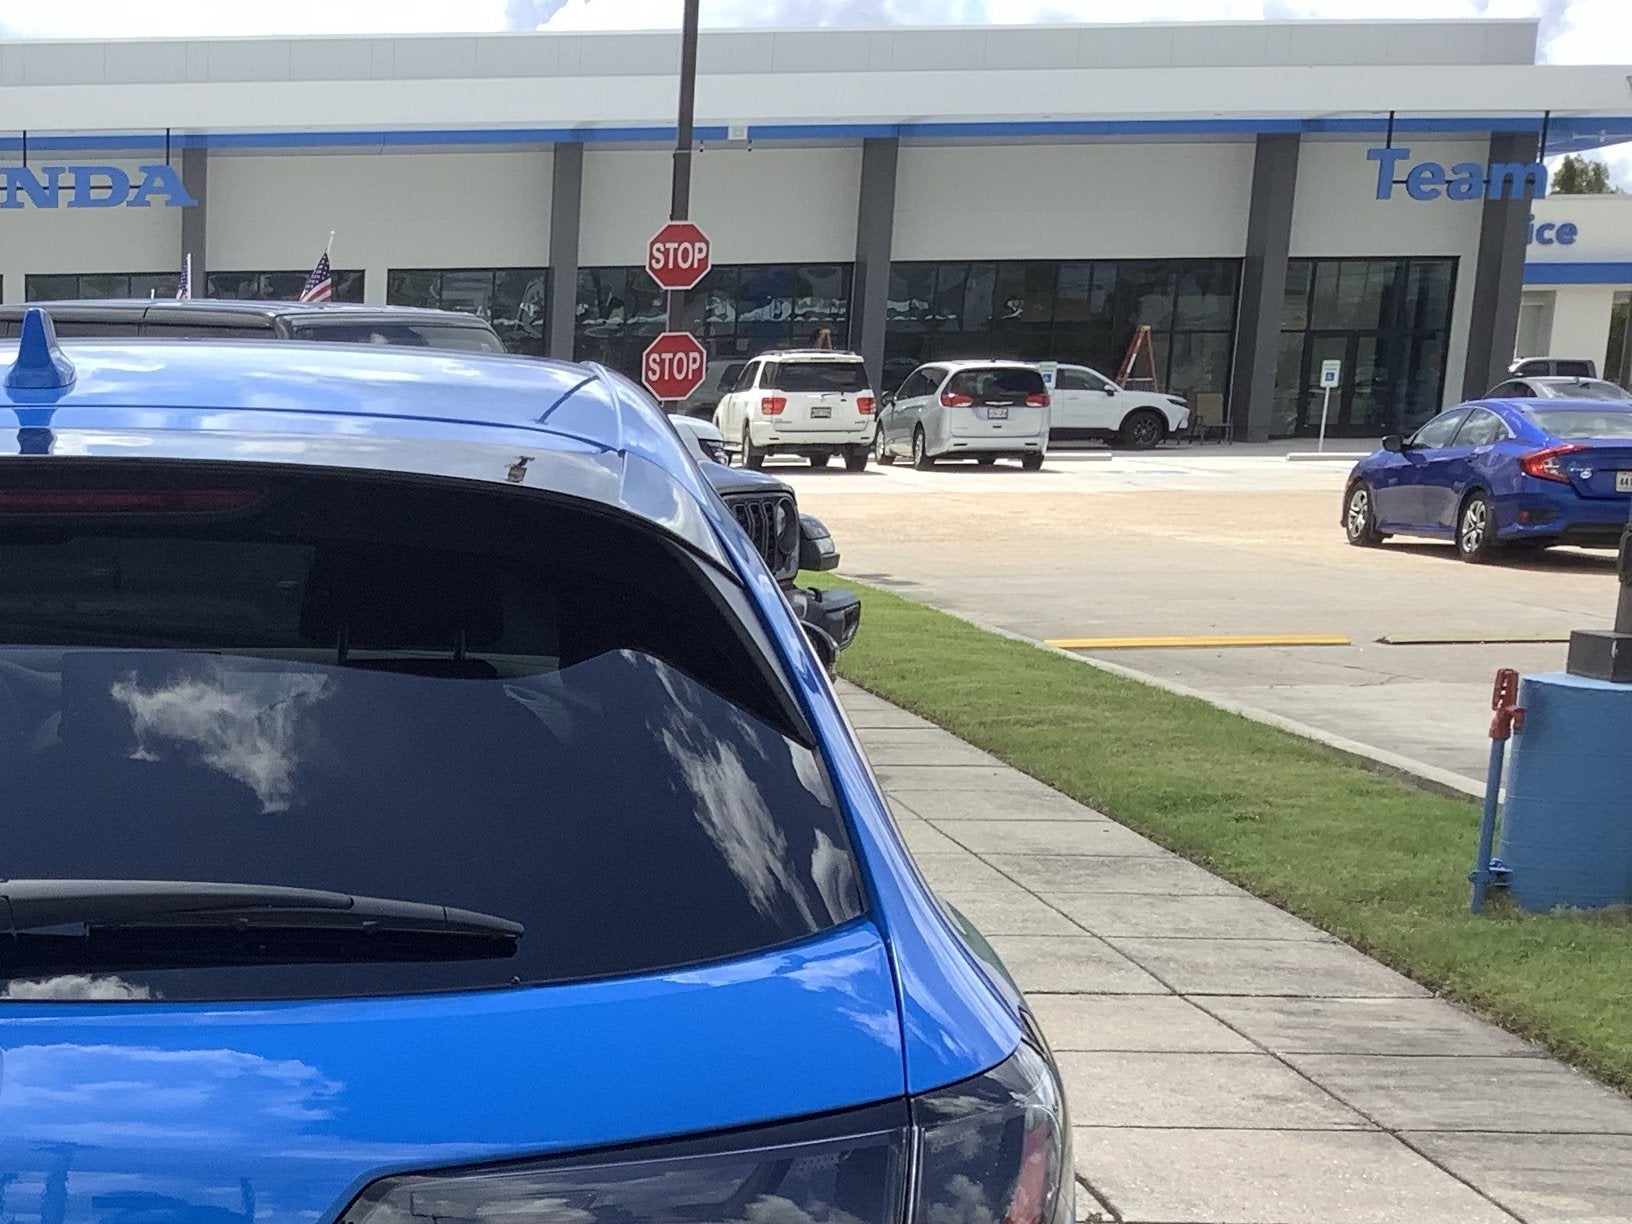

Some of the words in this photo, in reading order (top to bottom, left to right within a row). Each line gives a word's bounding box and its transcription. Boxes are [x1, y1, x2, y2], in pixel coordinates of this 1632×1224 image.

[1367, 148, 1548, 201] Team
[651, 242, 707, 270] STOP
[648, 352, 700, 381] STOP
